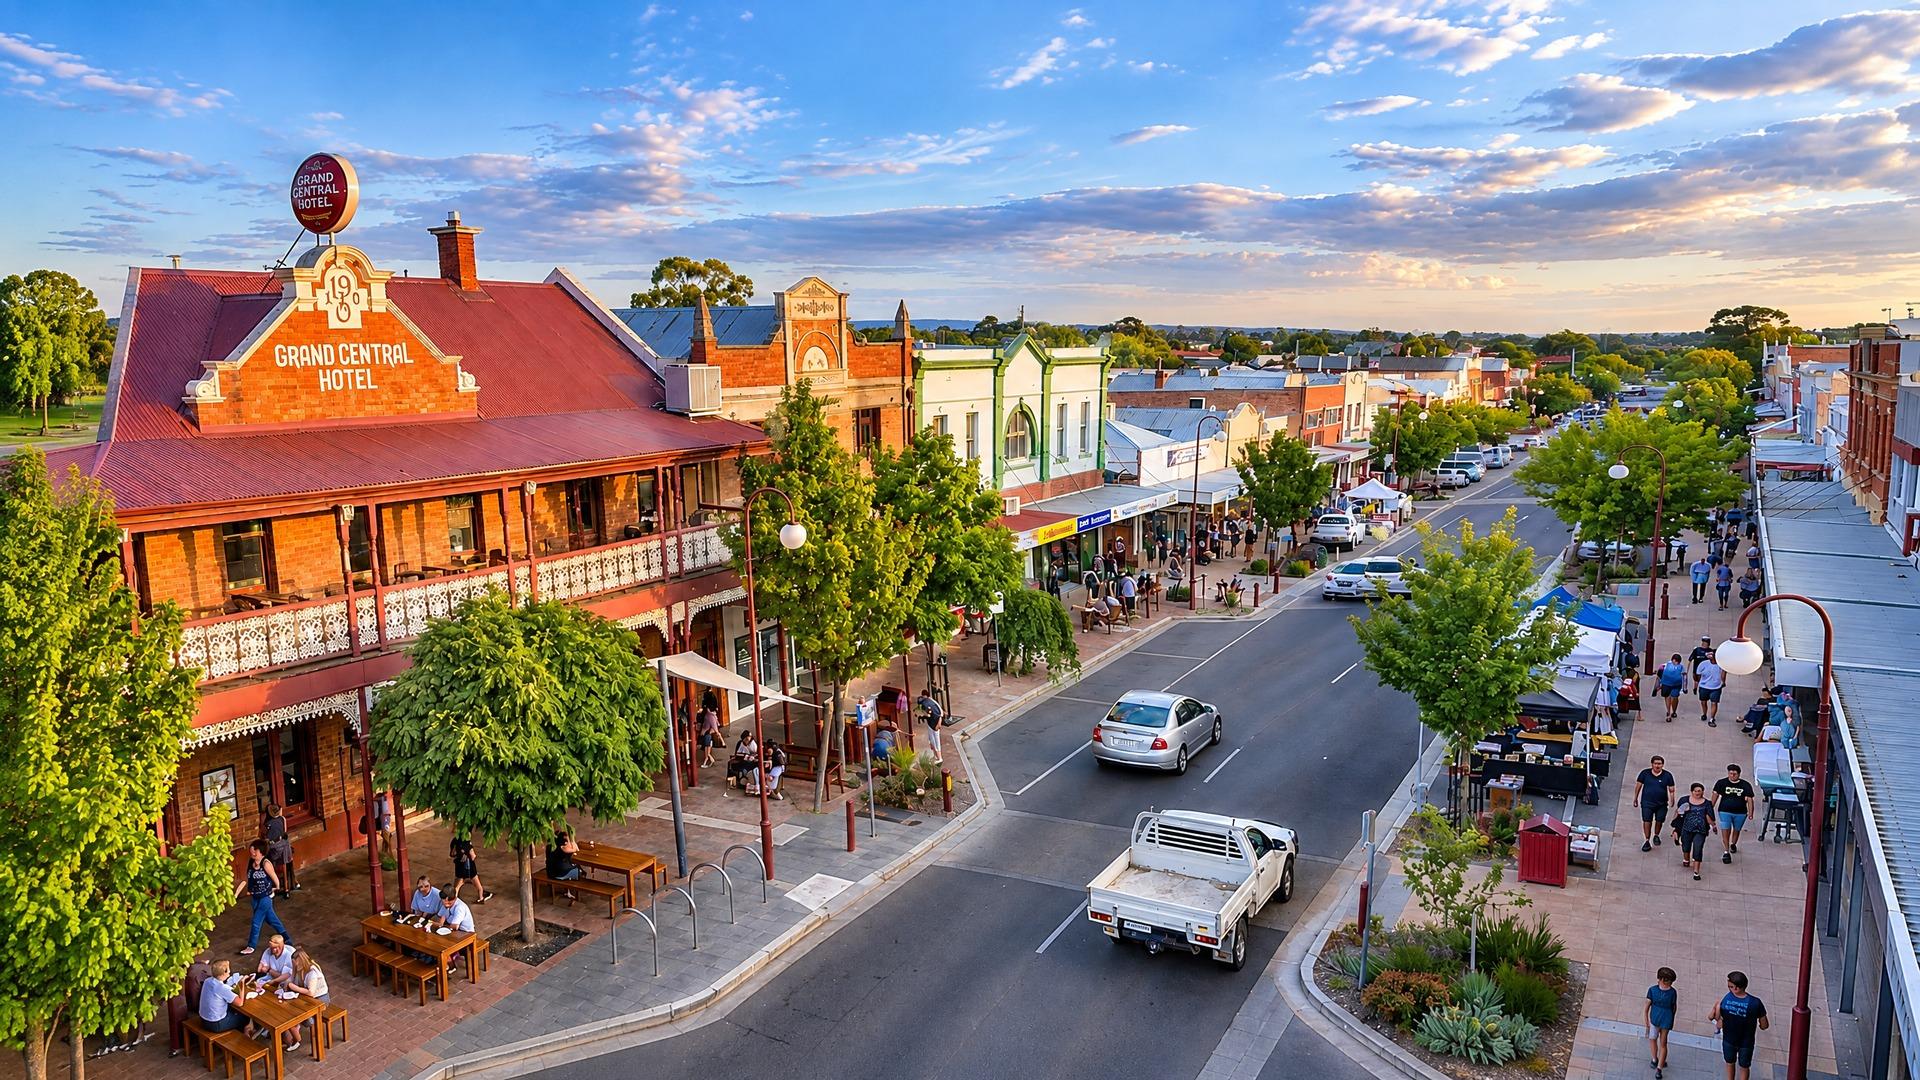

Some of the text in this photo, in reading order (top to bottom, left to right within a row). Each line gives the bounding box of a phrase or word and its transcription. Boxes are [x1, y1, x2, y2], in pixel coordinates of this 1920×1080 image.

[297, 172, 334, 186] GRAND
[292, 184, 340, 199] CENTRAL
[298, 196, 333, 209] HOTEL
[274, 342, 414, 369] GRAND CENTRAL
[318, 368, 378, 392] HOTEL
